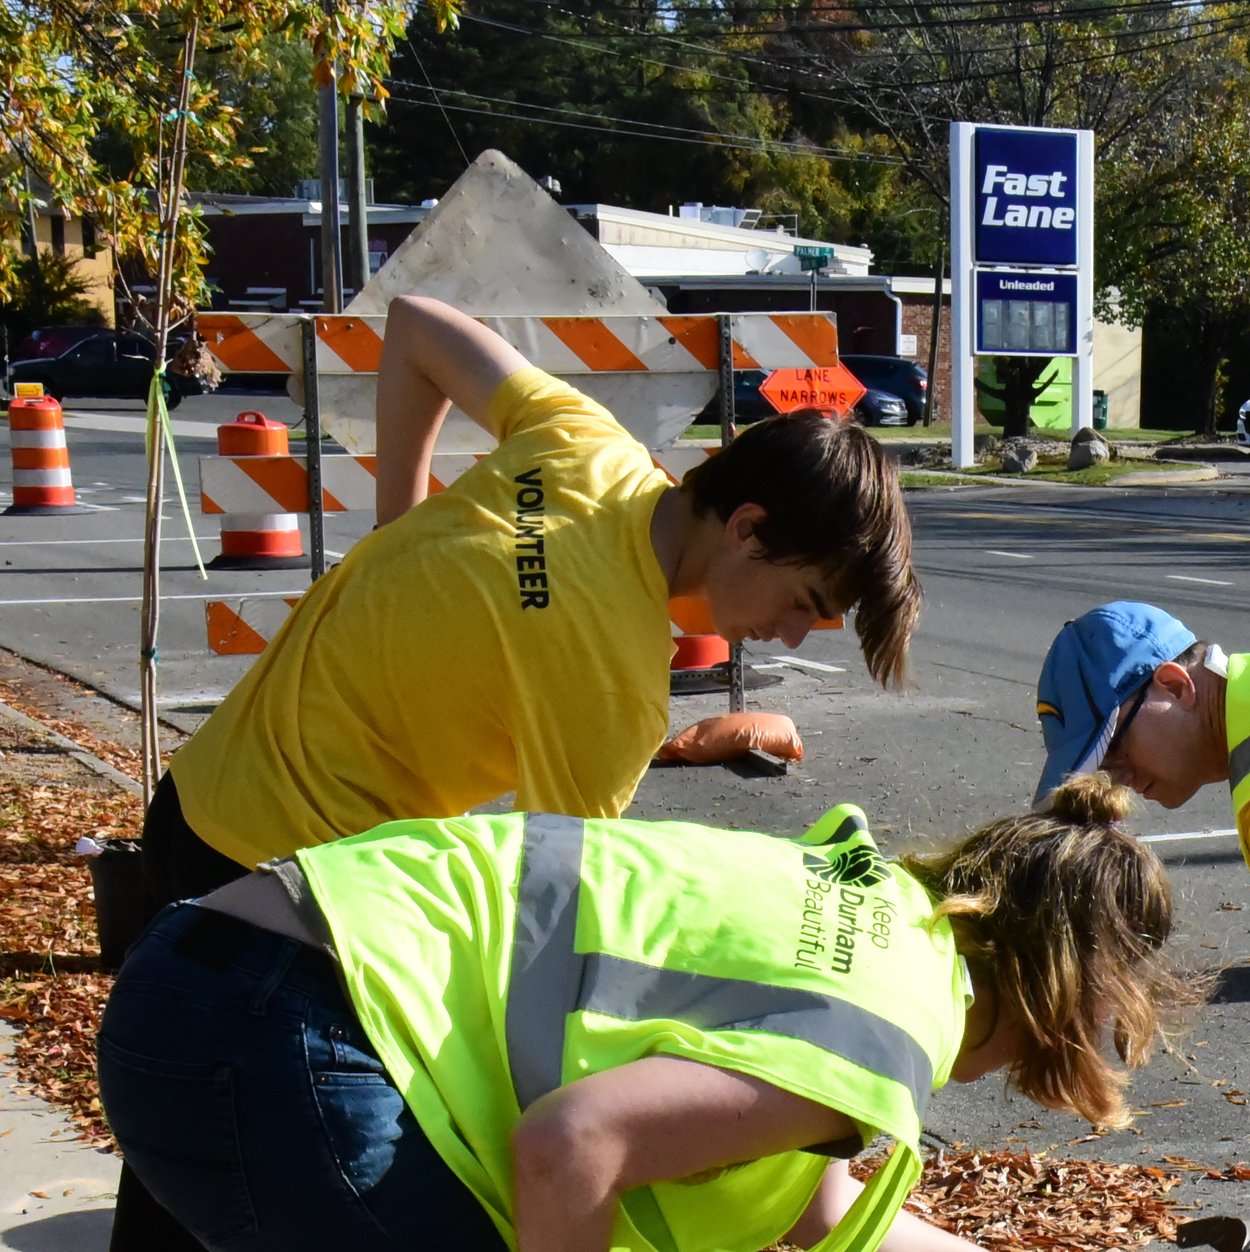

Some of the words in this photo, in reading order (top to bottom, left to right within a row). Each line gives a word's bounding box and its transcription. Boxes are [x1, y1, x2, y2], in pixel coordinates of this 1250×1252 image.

[982, 165, 1067, 198] Fast
[982, 197, 1075, 229] Lane
[1000, 279, 1054, 291] Unleaded
[796, 369, 829, 383] LANE
[780, 390, 846, 405] NARROWS
[514, 467, 549, 612] VOLUNTEER
[794, 878, 832, 972] Beautiful
[831, 887, 865, 975] Durham
[866, 896, 897, 950] Keep
